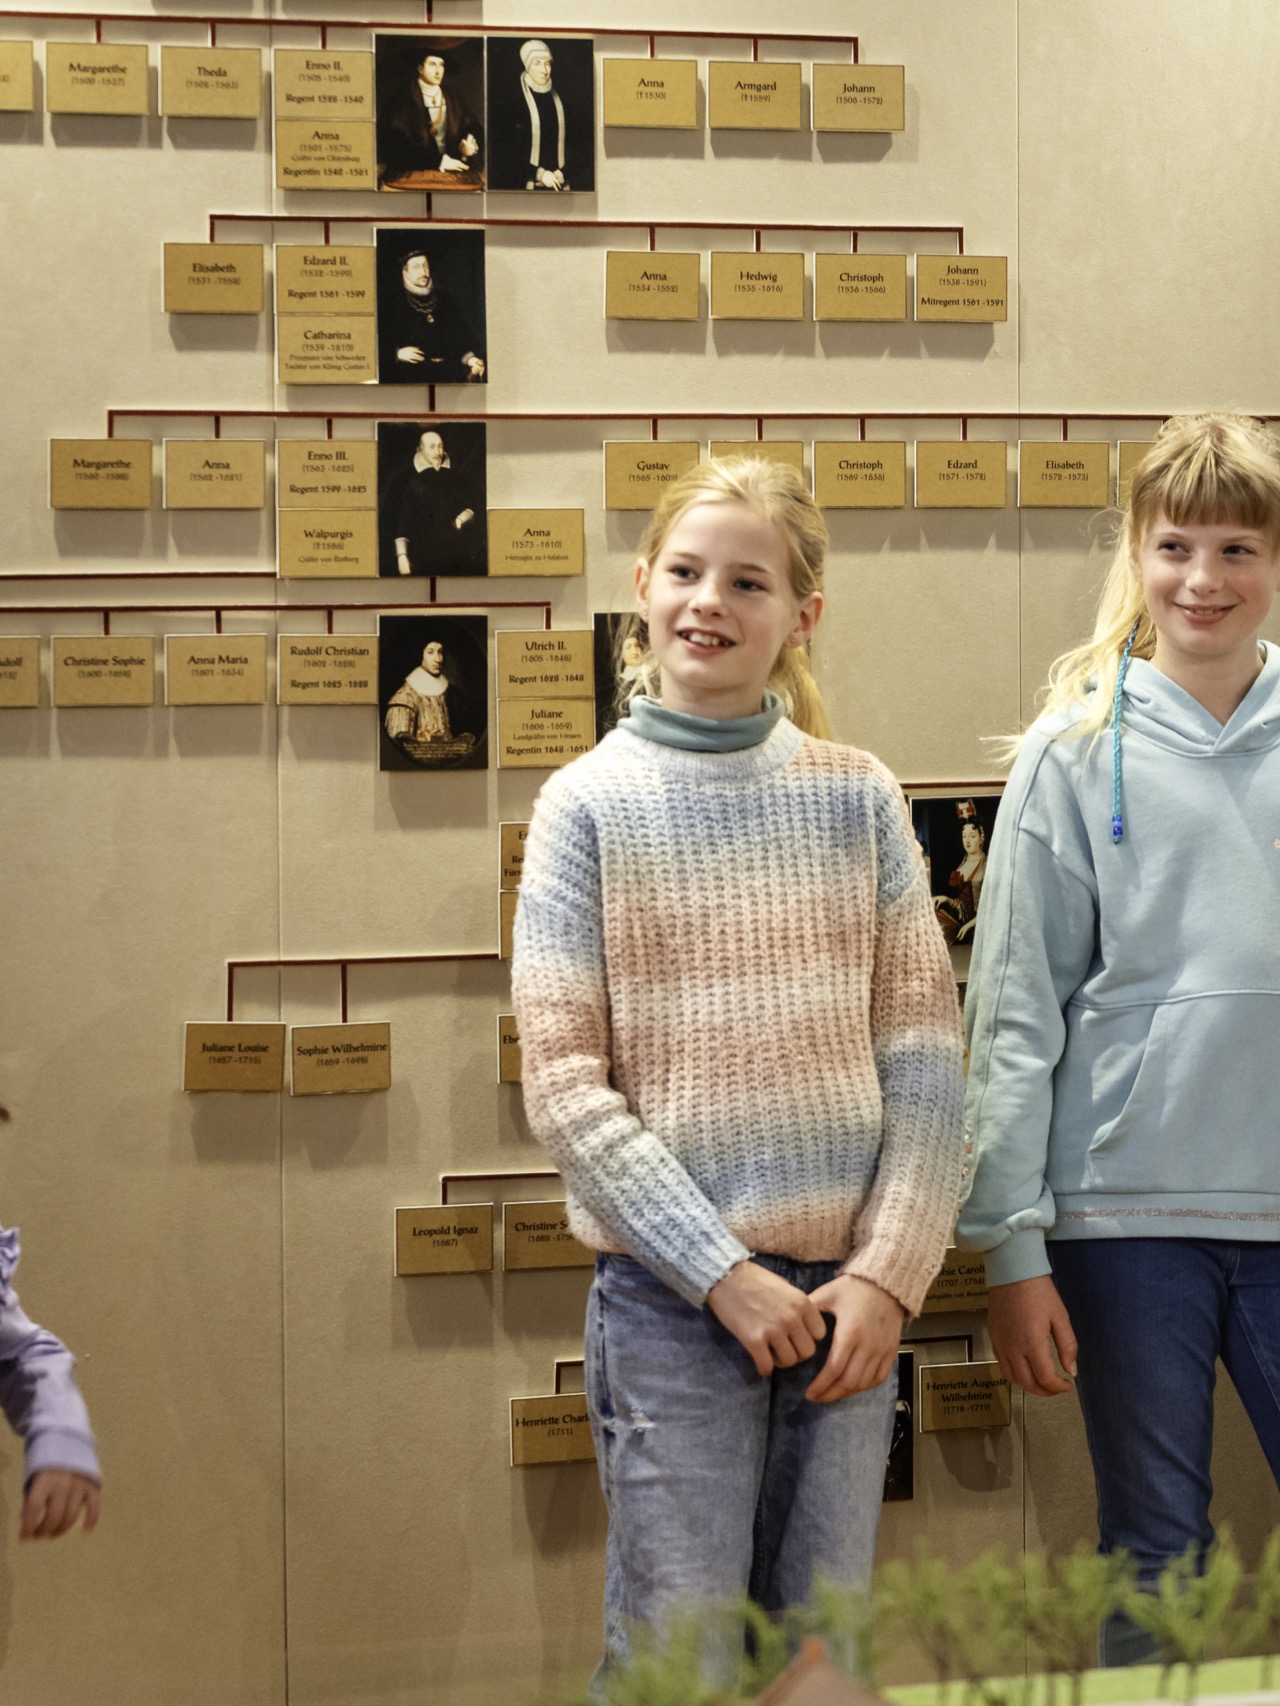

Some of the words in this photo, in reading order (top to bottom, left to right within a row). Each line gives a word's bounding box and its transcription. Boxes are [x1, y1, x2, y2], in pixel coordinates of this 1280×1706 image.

[69, 63, 127, 76] Margarethe
[306, 60, 331, 70] Enno
[198, 67, 228, 77] Theda
[638, 78, 664, 88] Anna
[735, 80, 777, 93] Armgard
[843, 83, 876, 94] Johann
[286, 93, 315, 105] Regent
[312, 131, 340, 141] Anna
[283, 167, 320, 178] Regentin
[303, 256, 336, 266] Edzard
[193, 263, 236, 273] Elisabeth
[947, 265, 979, 276] Johann
[641, 271, 667, 281] Anna
[740, 271, 778, 283] Hedwig
[839, 272, 884, 284] Christoph
[288, 289, 317, 300] Regent
[921, 297, 960, 308] Mitregent
[304, 330, 352, 340] Catharina
[308, 451, 333, 461] Enno
[72, 459, 132, 471] Margarethe
[202, 460, 230, 469] Anna
[637, 461, 669, 471] Gustav
[839, 460, 883, 471] Christoph
[948, 460, 977, 469] Edzard
[1046, 460, 1084, 470] Elisabeth
[289, 485, 319, 495] Regent
[304, 529, 353, 540] Walpurgis
[524, 528, 551, 537] Anna
[290, 646, 322, 656] Rudolf
[325, 646, 370, 656] Christian
[525, 641, 555, 651] Ulrich
[63, 657, 109, 666] Christine
[112, 656, 146, 667] Sophie
[188, 656, 216, 665] Anna
[218, 655, 248, 664] Maria
[290, 680, 320, 690] Regent
[509, 675, 537, 685] Regent
[531, 709, 563, 720] Juliane
[506, 746, 542, 756] Regentin
[202, 1043, 235, 1053] Juliane
[238, 1043, 269, 1053] Louise
[297, 1045, 329, 1057] Sophie
[331, 1042, 387, 1054] Wilhelmine
[413, 1226, 451, 1238] Leopold
[453, 1225, 478, 1236] Ignaz
[515, 1221, 558, 1232] Christine
[957, 1264, 985, 1275] Caroli
[927, 1380, 968, 1391] Henriette
[971, 1377, 1010, 1390] Auguste
[941, 1391, 993, 1402] Wilhelmine
[516, 1416, 560, 1427] Henriette
[562, 1413, 590, 1424] Charl
